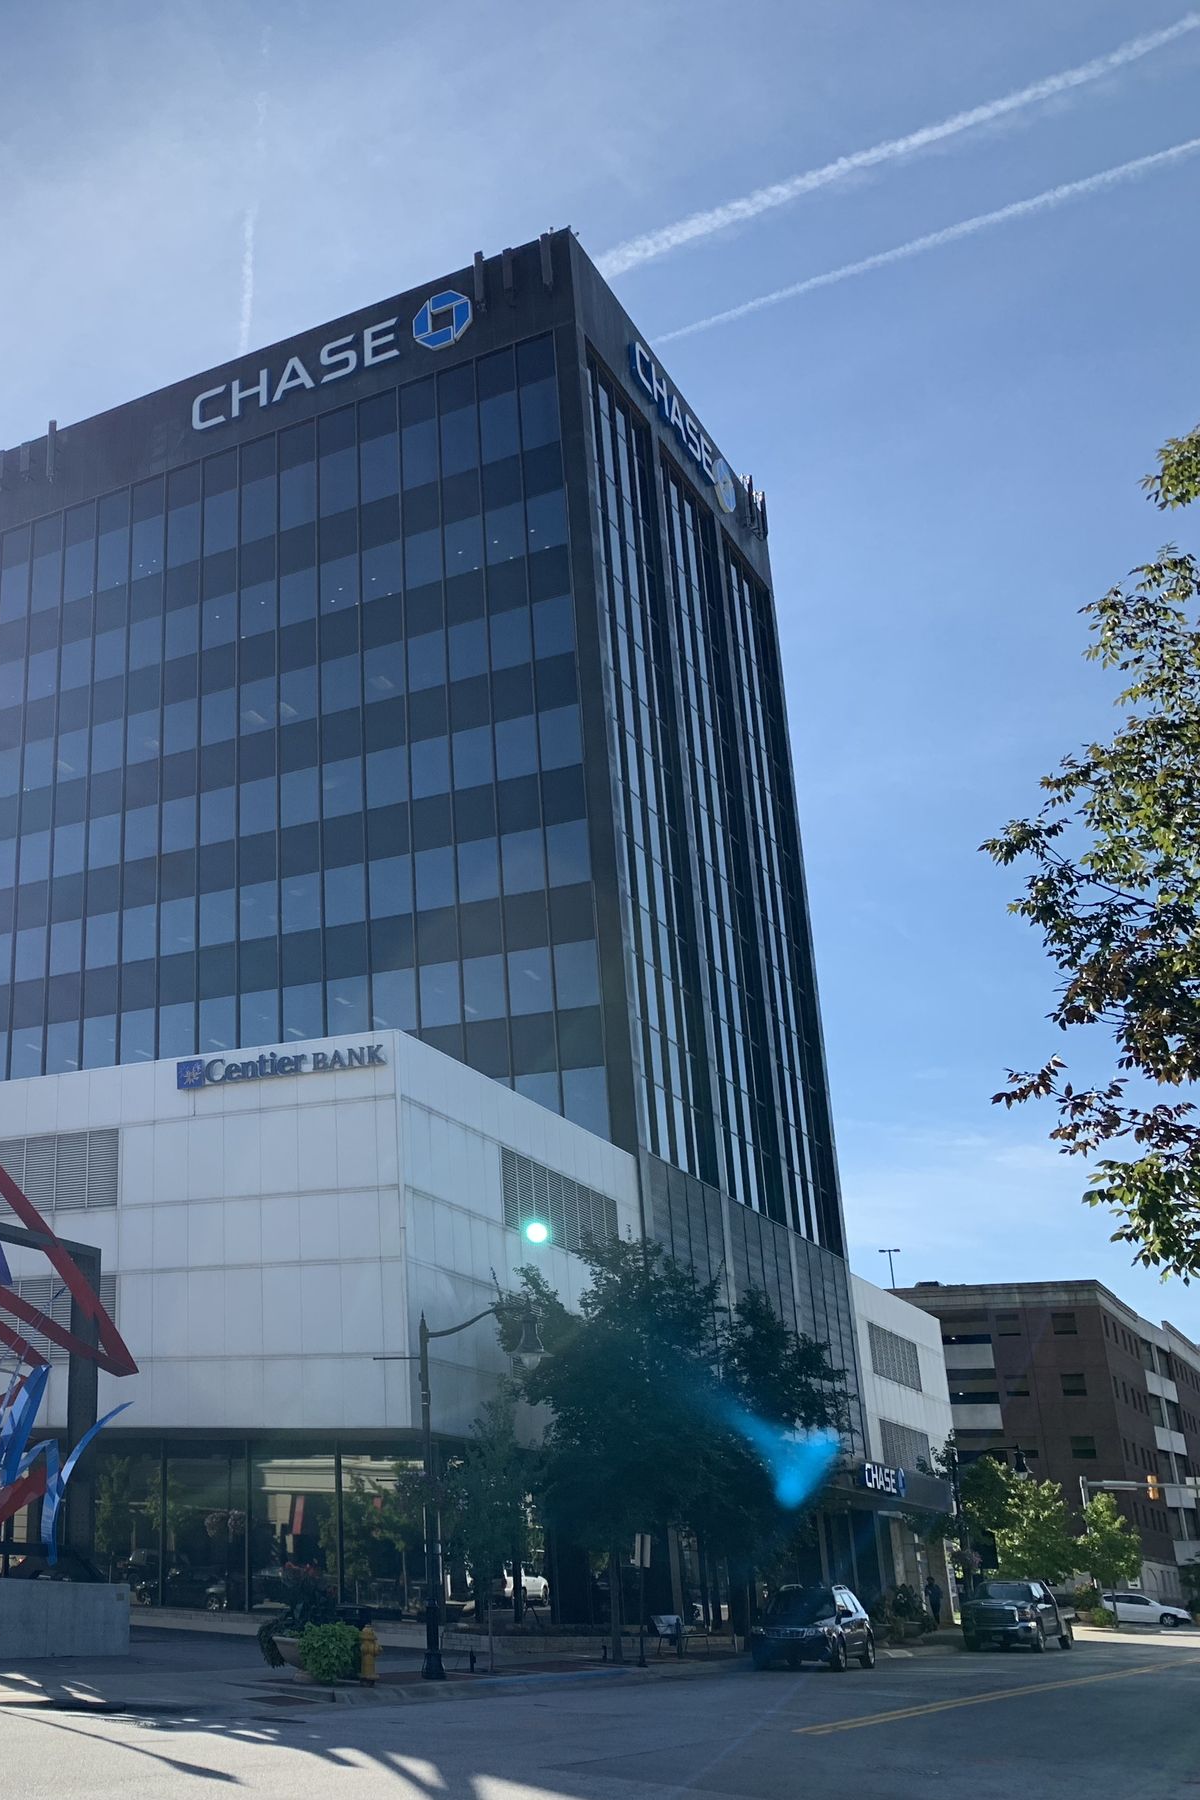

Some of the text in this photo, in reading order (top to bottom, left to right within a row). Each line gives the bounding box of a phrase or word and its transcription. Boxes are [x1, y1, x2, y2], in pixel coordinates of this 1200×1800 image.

[191, 316, 400, 431] CHASE
[632, 341, 717, 485] CHASE
[204, 1044, 388, 1084] Centier BANK
[865, 1463, 898, 1494] CHASE
